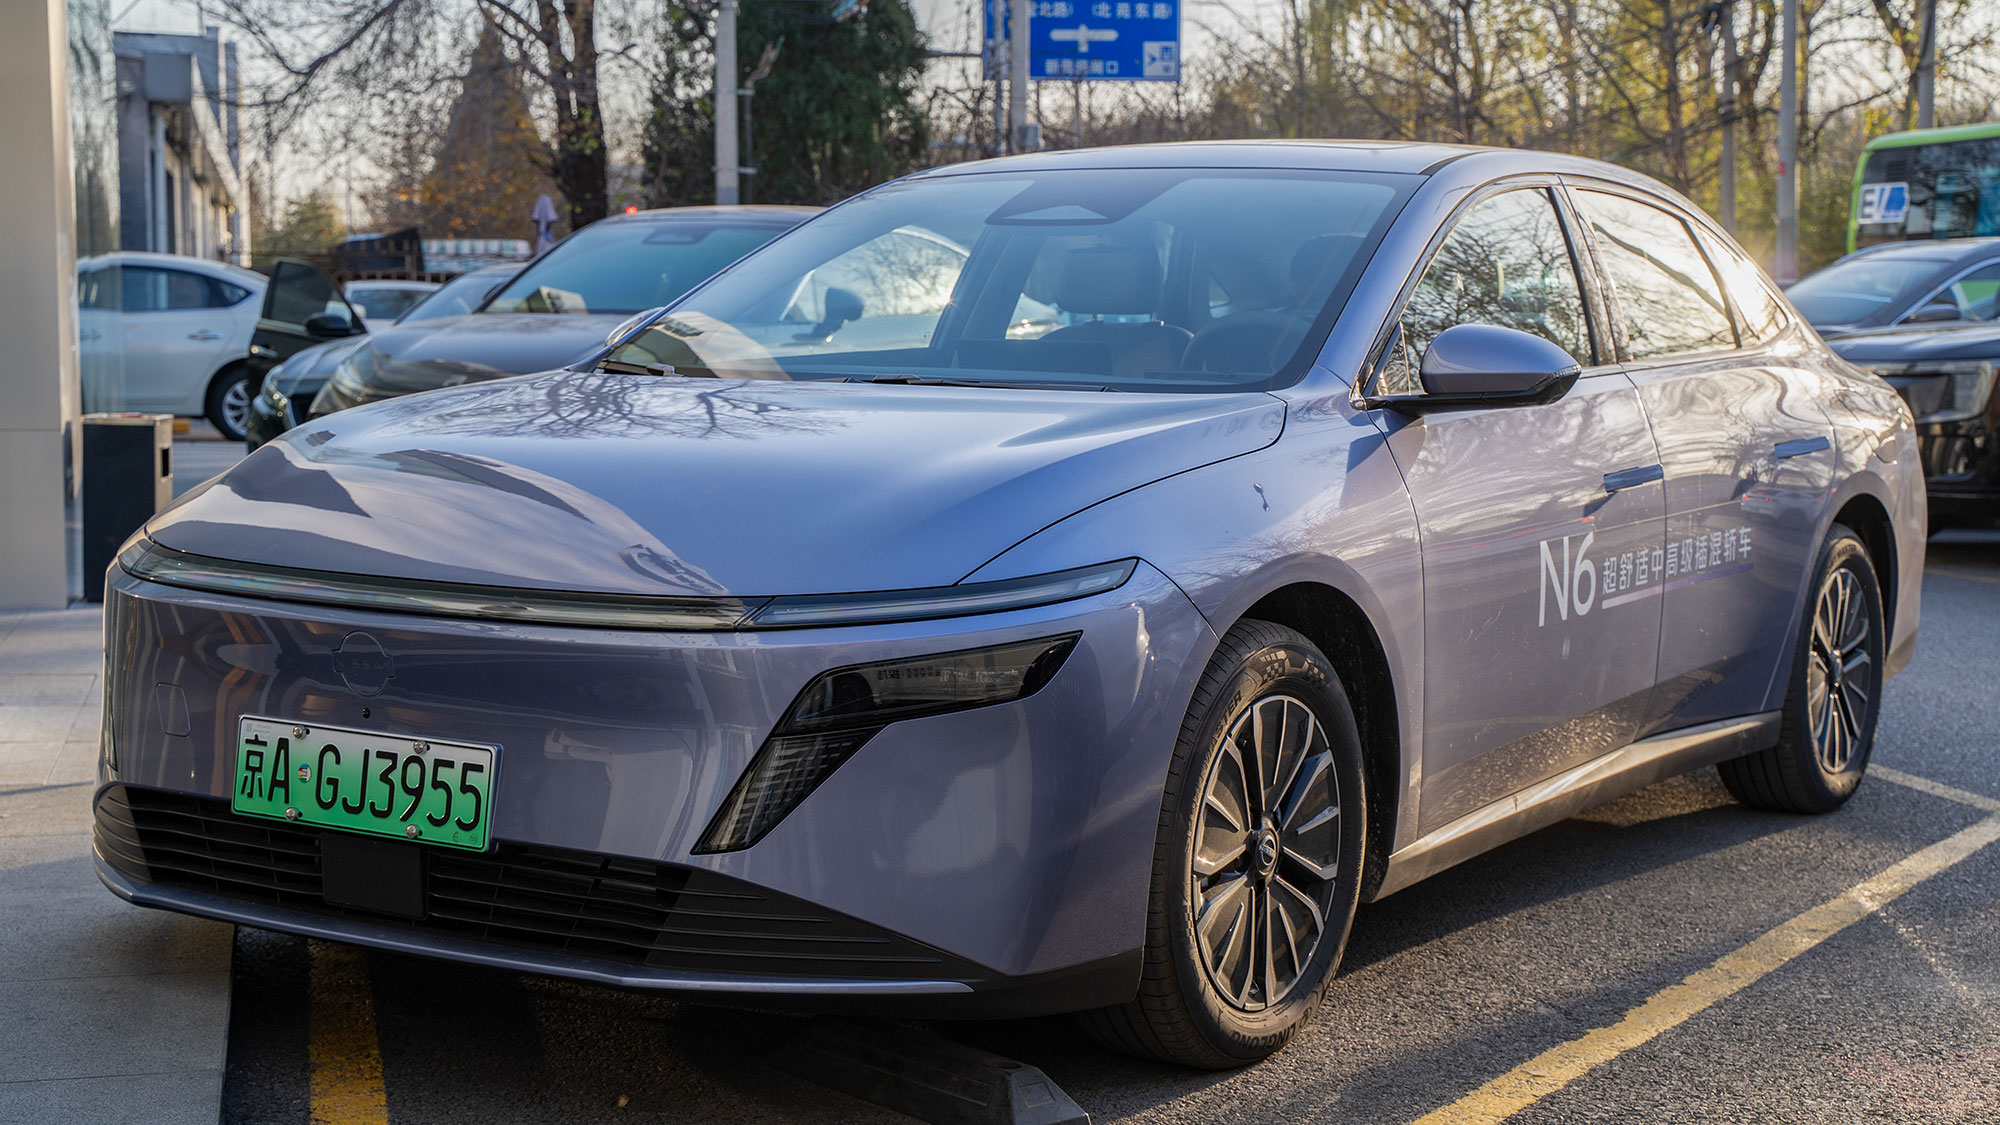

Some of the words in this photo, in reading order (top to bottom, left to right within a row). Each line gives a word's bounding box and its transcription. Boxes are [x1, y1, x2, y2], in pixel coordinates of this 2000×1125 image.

[1538, 531, 1597, 627] N6
[1602, 526, 1753, 595] 超舒适中高级插混轿车
[1230, 1022, 1297, 1051] LINGLONG
